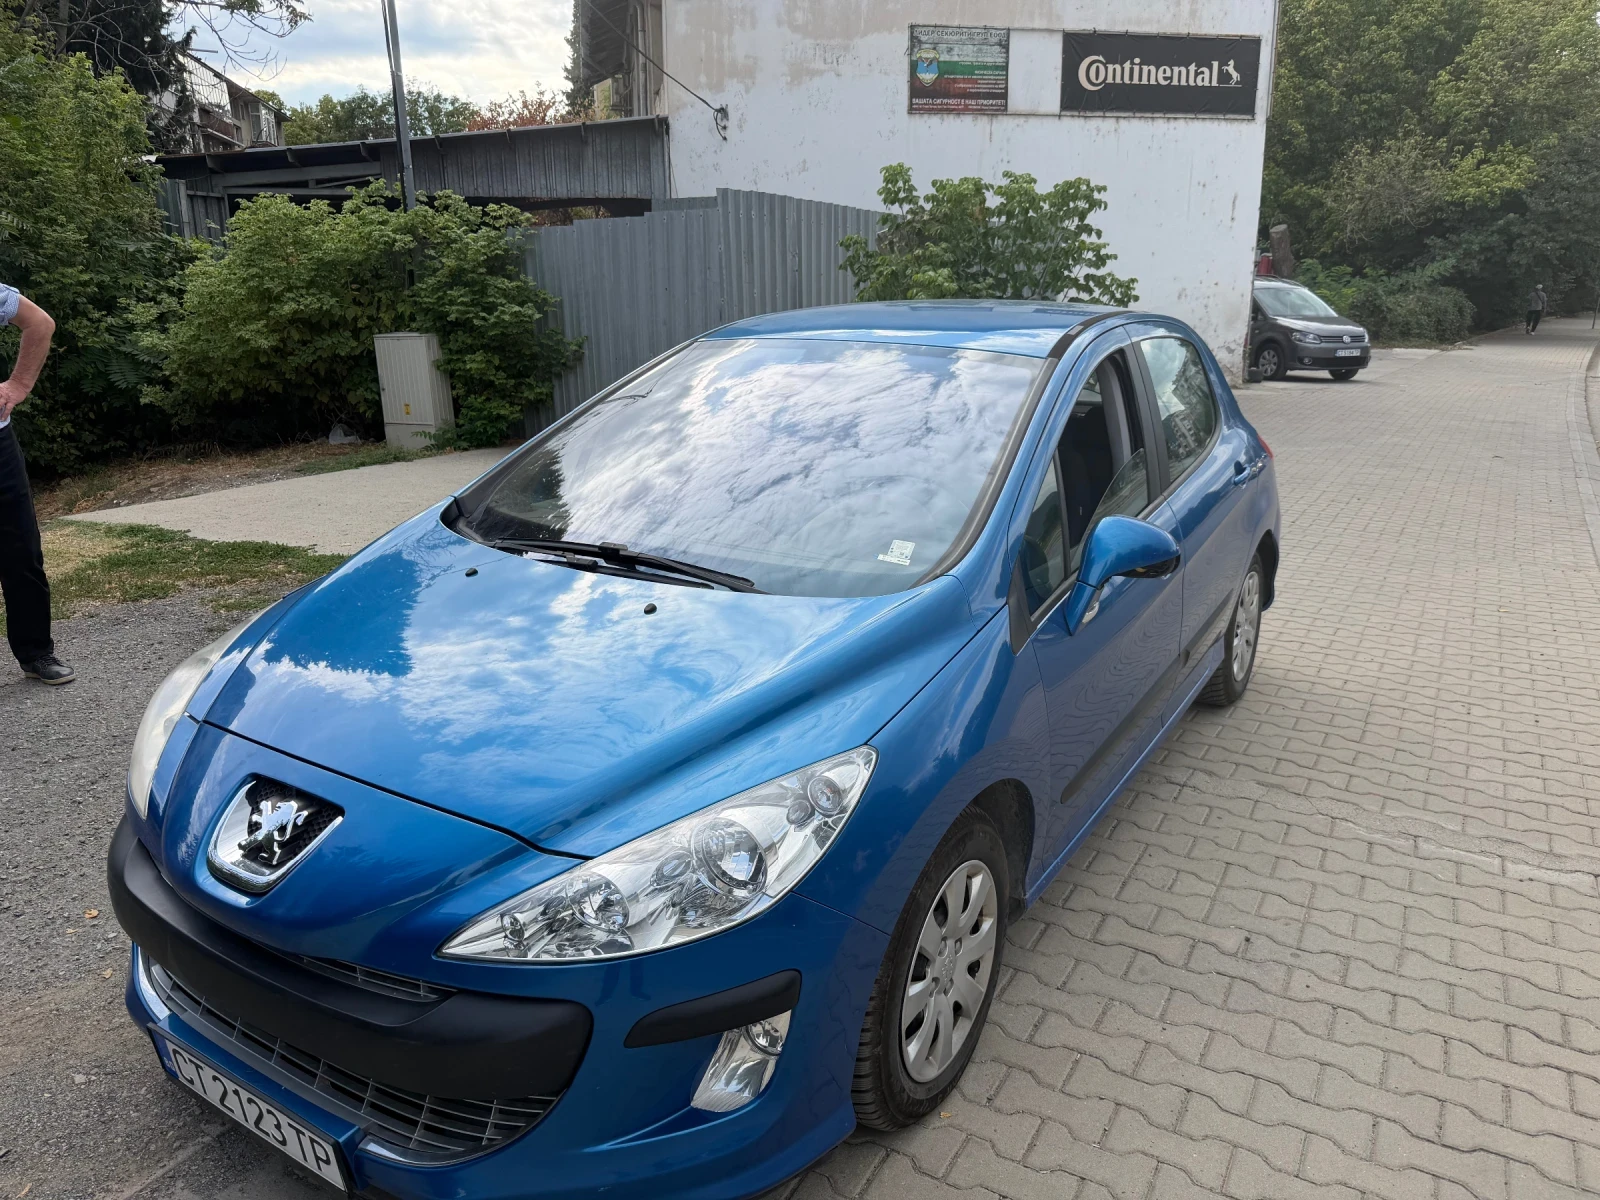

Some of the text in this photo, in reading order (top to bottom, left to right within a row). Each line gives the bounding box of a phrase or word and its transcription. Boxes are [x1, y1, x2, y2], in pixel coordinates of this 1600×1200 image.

[1077, 54, 1219, 91] Continental
[965, 98, 977, 106] НАШ
[172, 1047, 331, 1172] CT 2123 TP
